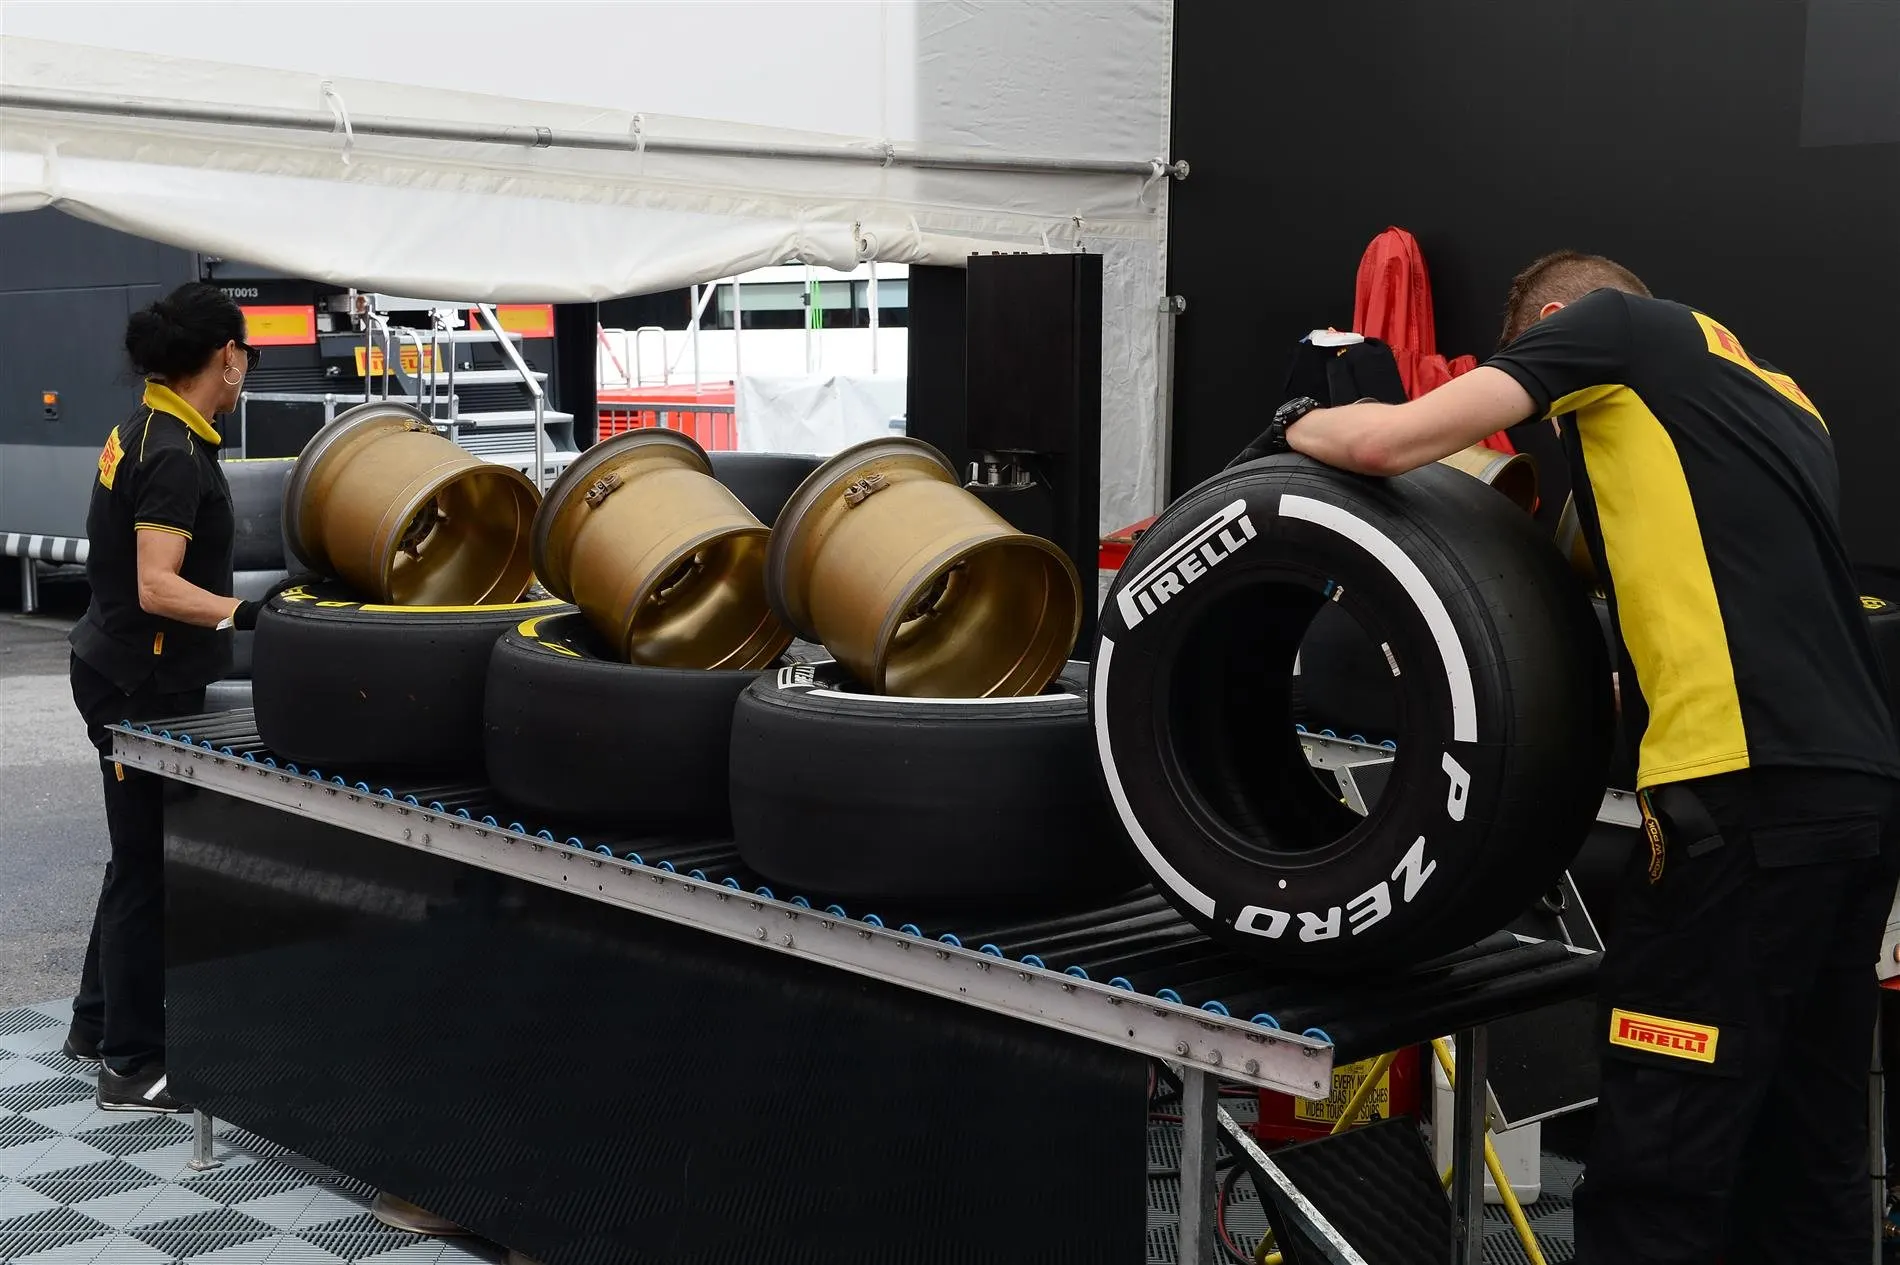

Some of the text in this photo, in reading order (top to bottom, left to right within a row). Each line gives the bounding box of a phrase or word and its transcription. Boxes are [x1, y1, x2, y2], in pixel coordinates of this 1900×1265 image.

[1116, 499, 1257, 630] PIRELLI
[1234, 752, 1471, 943] P ZERO
[1619, 1018, 1708, 1053] PIRELLI
[1334, 1074, 1355, 1089] EVERY
[1305, 1101, 1324, 1117] VIDER
[1326, 1104, 1344, 1120] TOUS
